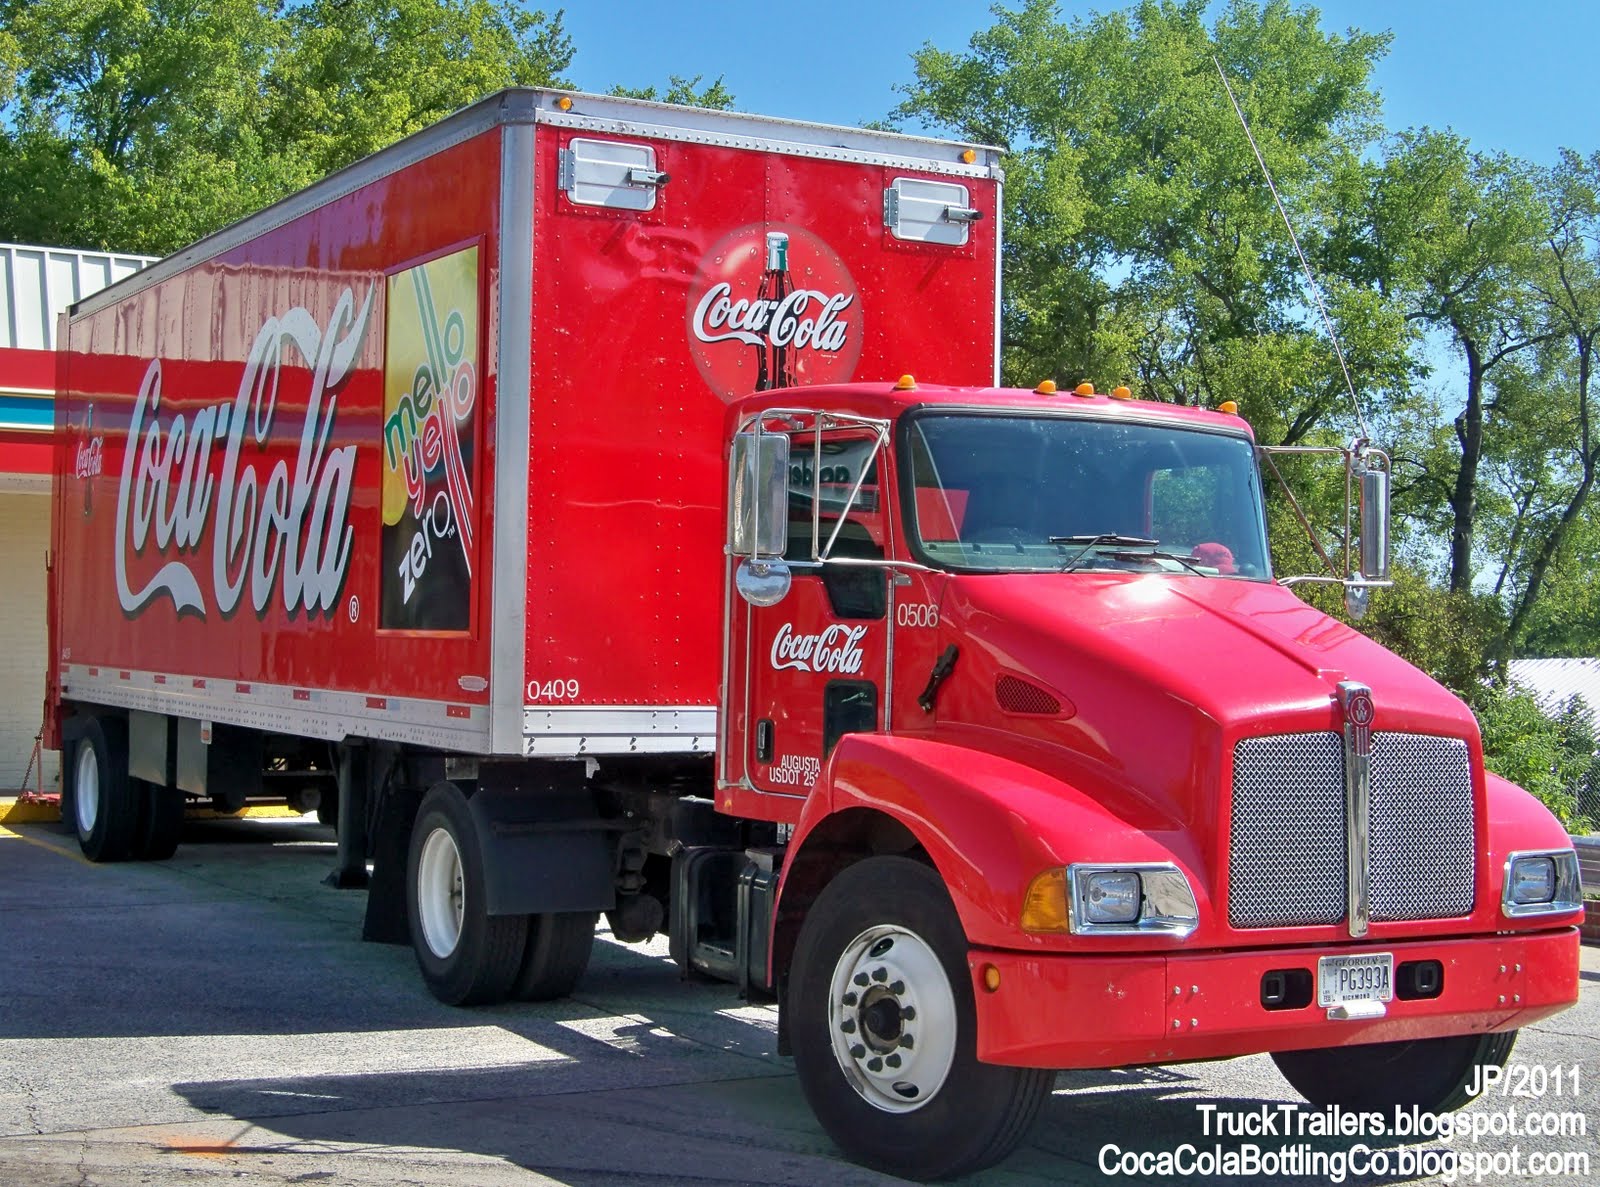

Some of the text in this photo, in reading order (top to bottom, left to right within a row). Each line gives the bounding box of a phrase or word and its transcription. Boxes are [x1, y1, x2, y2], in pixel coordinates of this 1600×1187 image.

[692, 282, 854, 351] Coca-Cola
[384, 264, 464, 472] mello
[114, 277, 375, 616] Coca-Cola
[398, 490, 450, 605] zero
[897, 603, 939, 628] 0506
[770, 622, 868, 674] Coca-Cola
[527, 679, 579, 700] 0409
[769, 766, 800, 785] USDOT
[780, 754, 821, 773] AUGUSTA
[1340, 965, 1390, 991] PG393A
